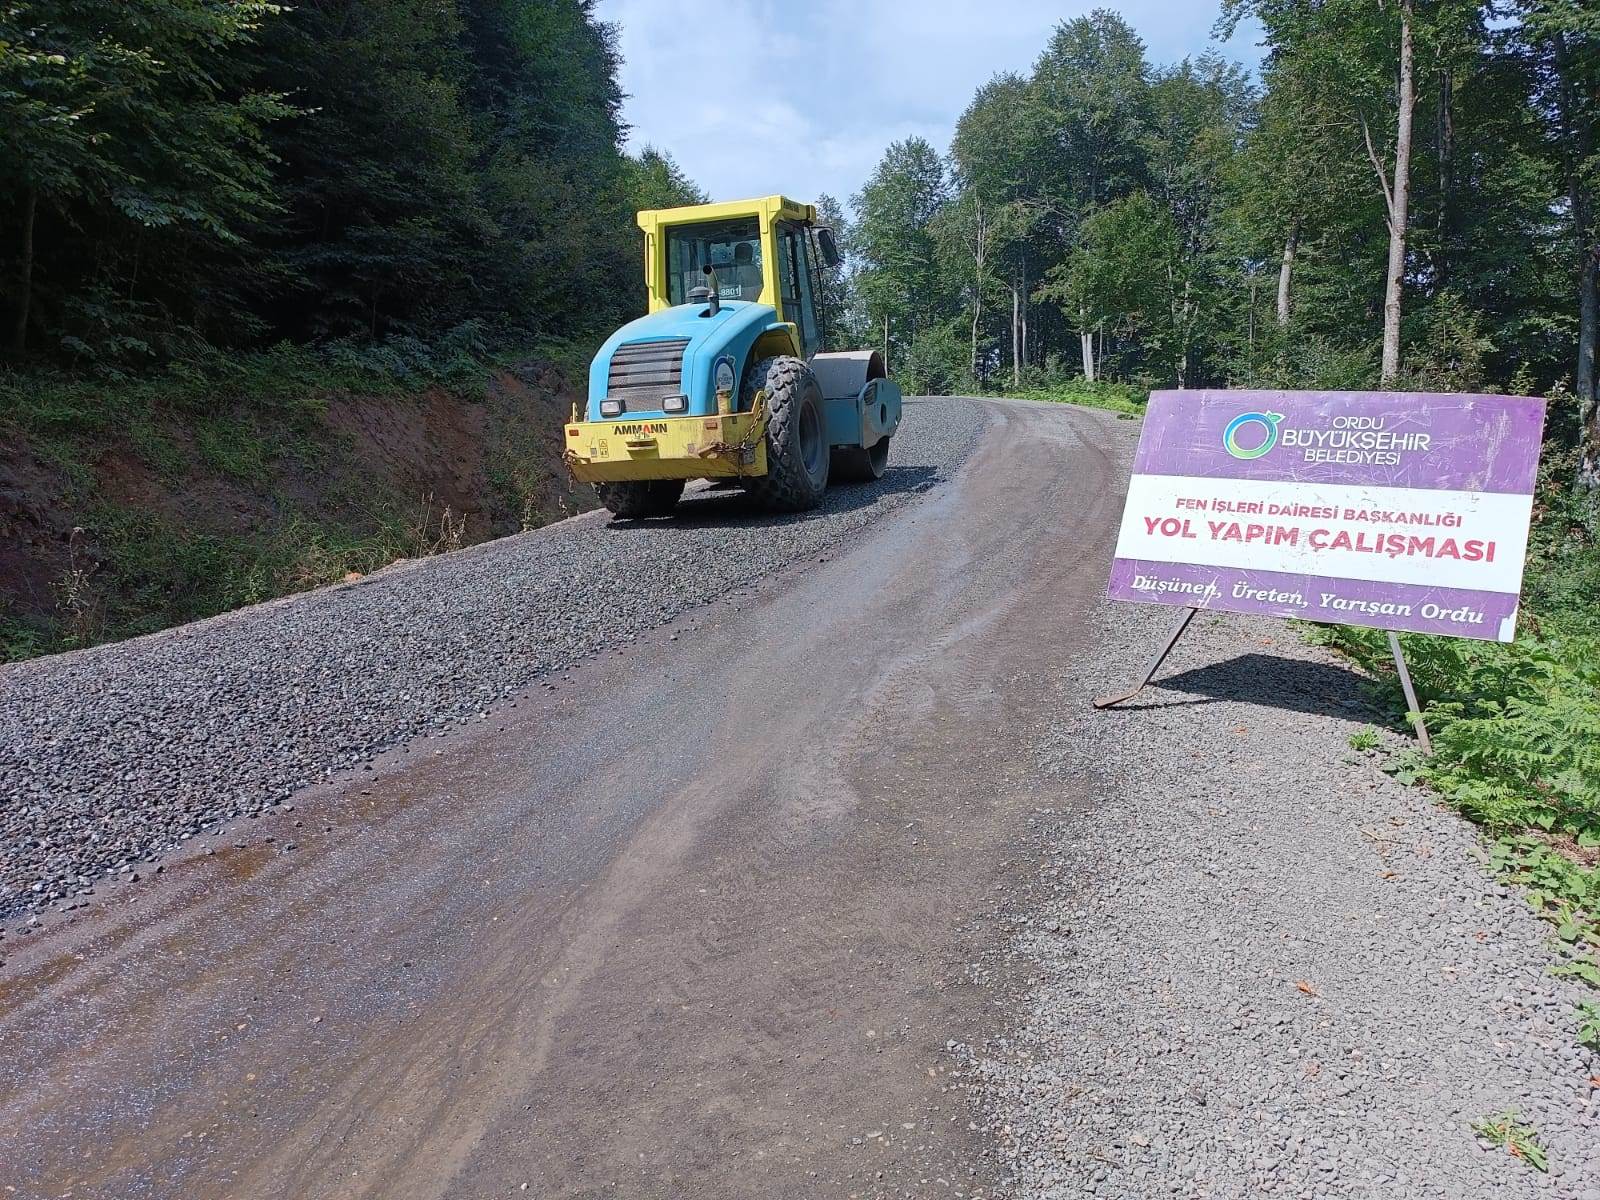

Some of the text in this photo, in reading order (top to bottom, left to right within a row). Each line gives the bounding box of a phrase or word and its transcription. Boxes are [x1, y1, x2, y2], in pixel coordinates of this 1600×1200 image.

[613, 423, 668, 436] AMMANN
[1332, 416, 1385, 430] ORDU
[1175, 497, 1464, 528] FEN İŞLERİ DAİRESİ BAŞKANLIĞI
[1144, 516, 1497, 563] YOL YAPIM ÇALIŞMASI
[1130, 575, 1485, 625] Düşünen, Üreten, Yarışan Ordu
